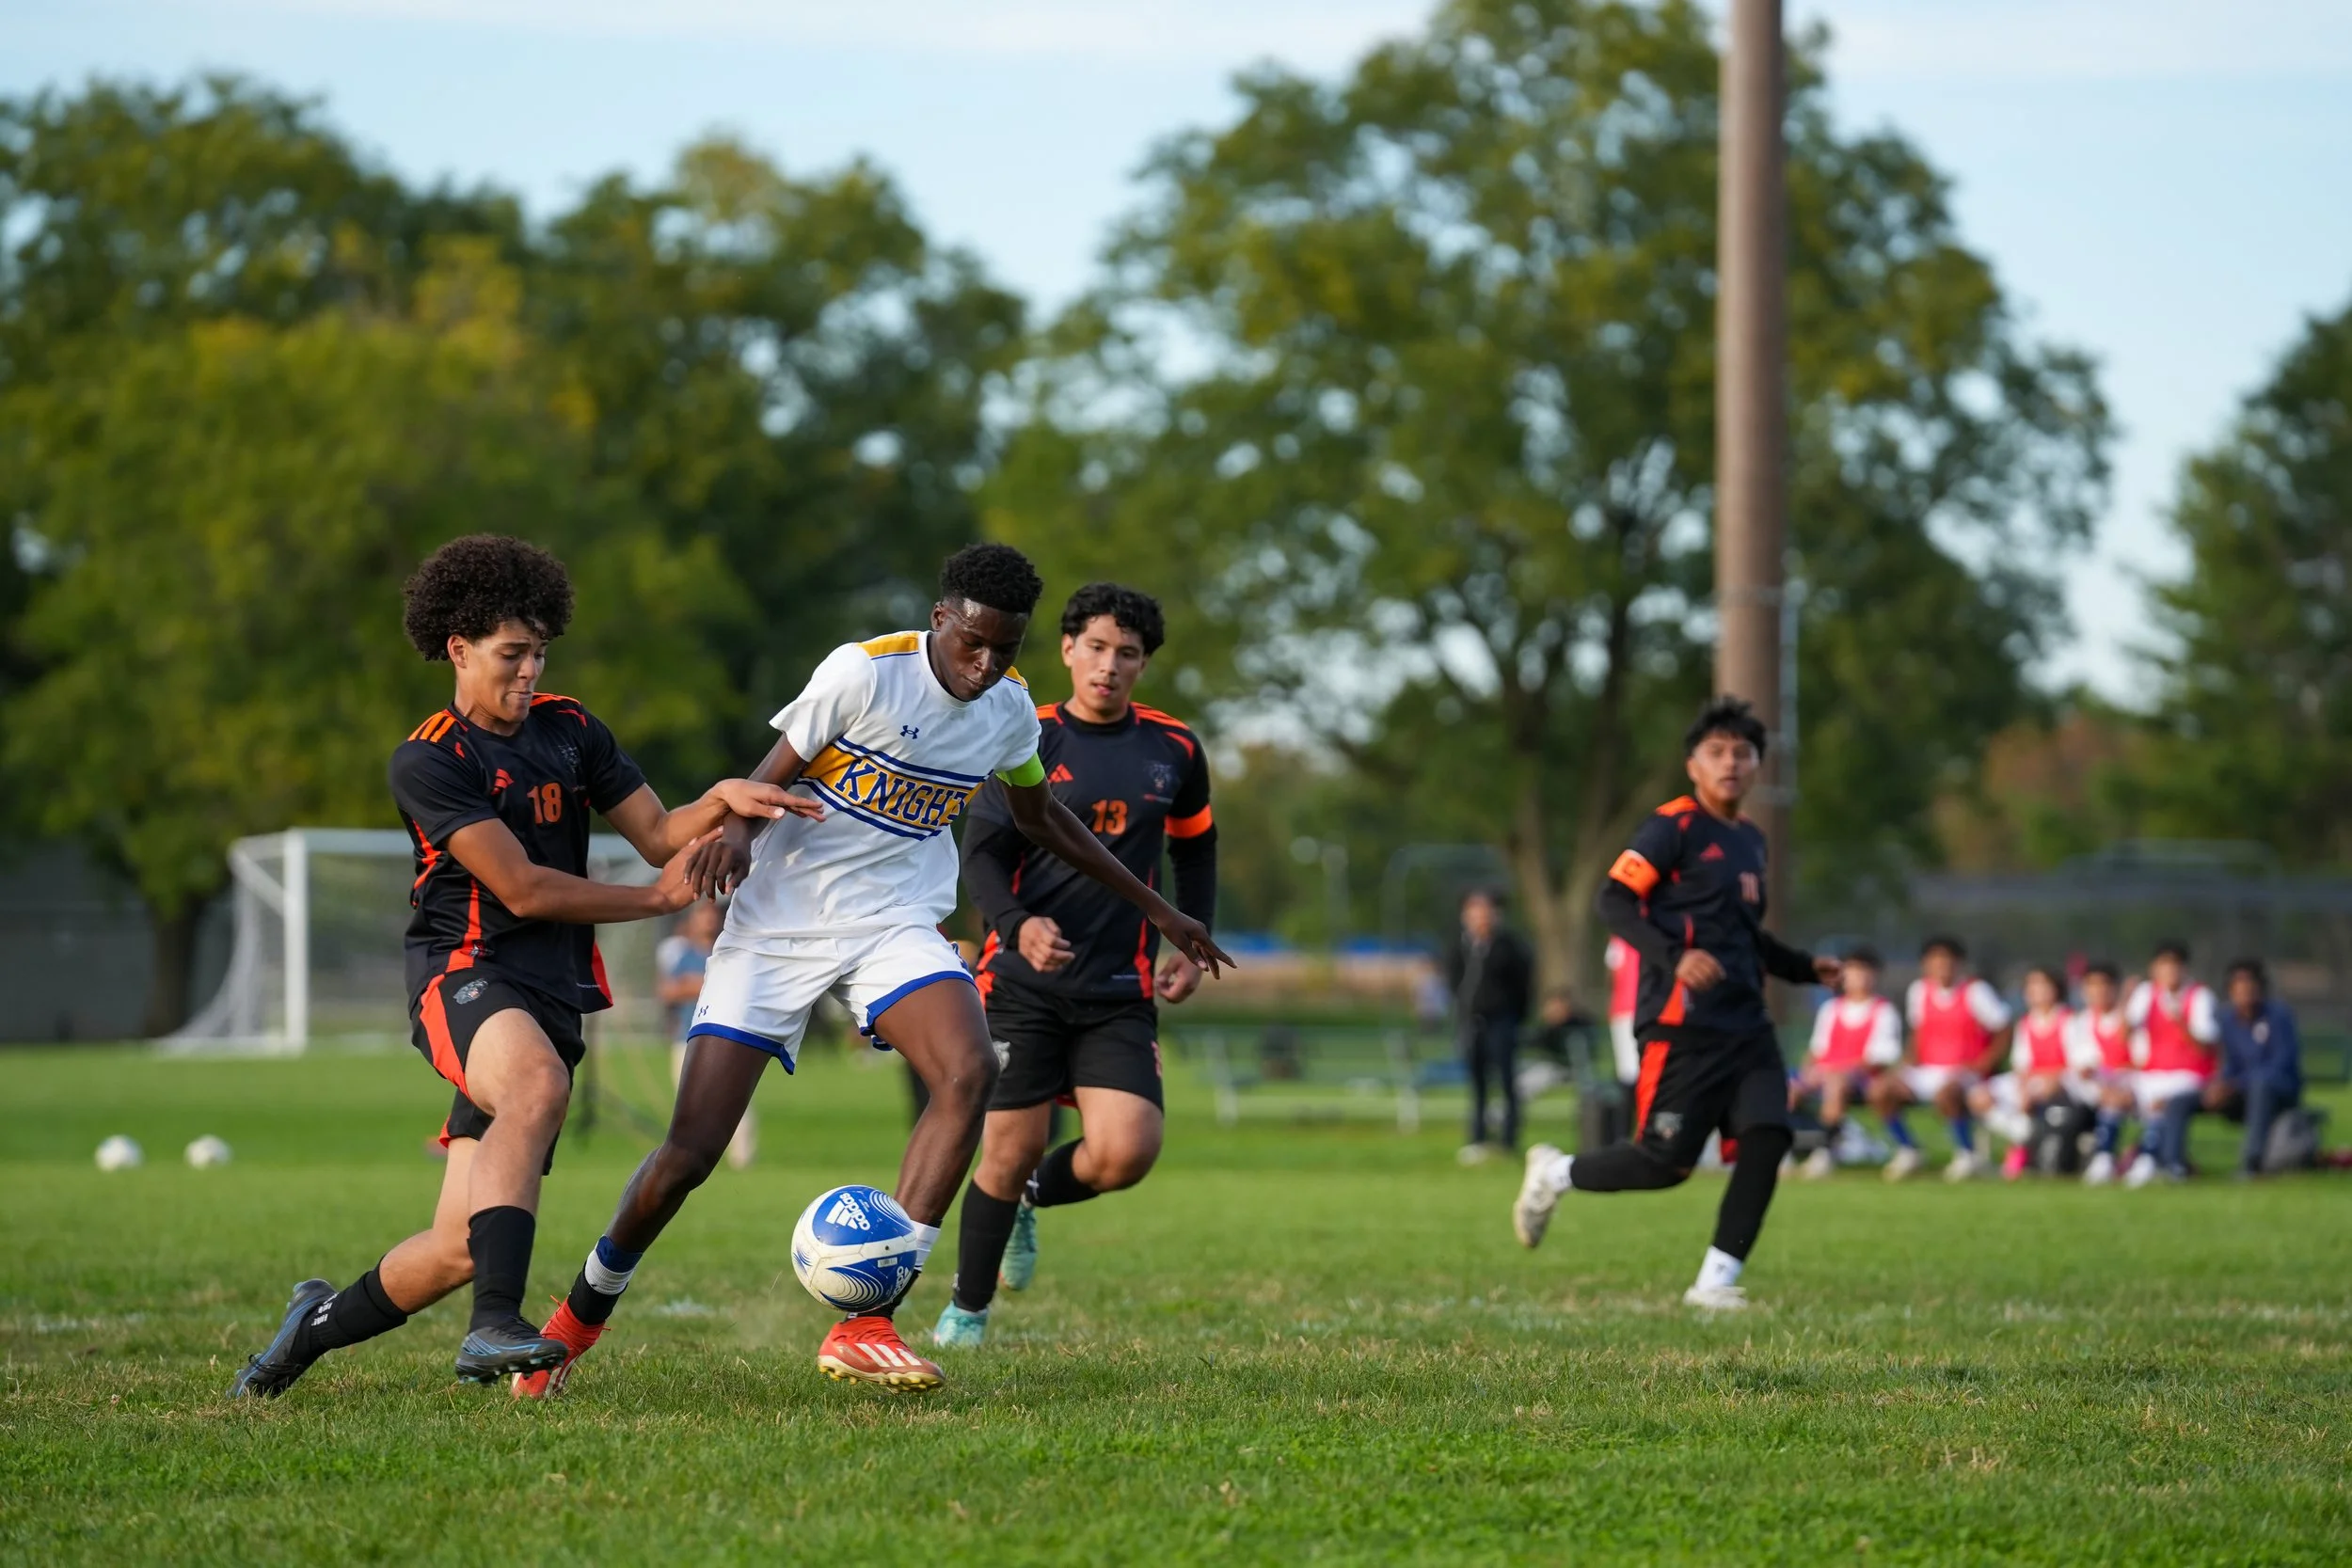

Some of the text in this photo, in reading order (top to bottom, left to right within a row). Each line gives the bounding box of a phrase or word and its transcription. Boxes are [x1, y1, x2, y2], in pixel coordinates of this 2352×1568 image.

[527, 783, 562, 824] 18
[1092, 800, 1128, 835] 13
[839, 1193, 870, 1230] adidas
